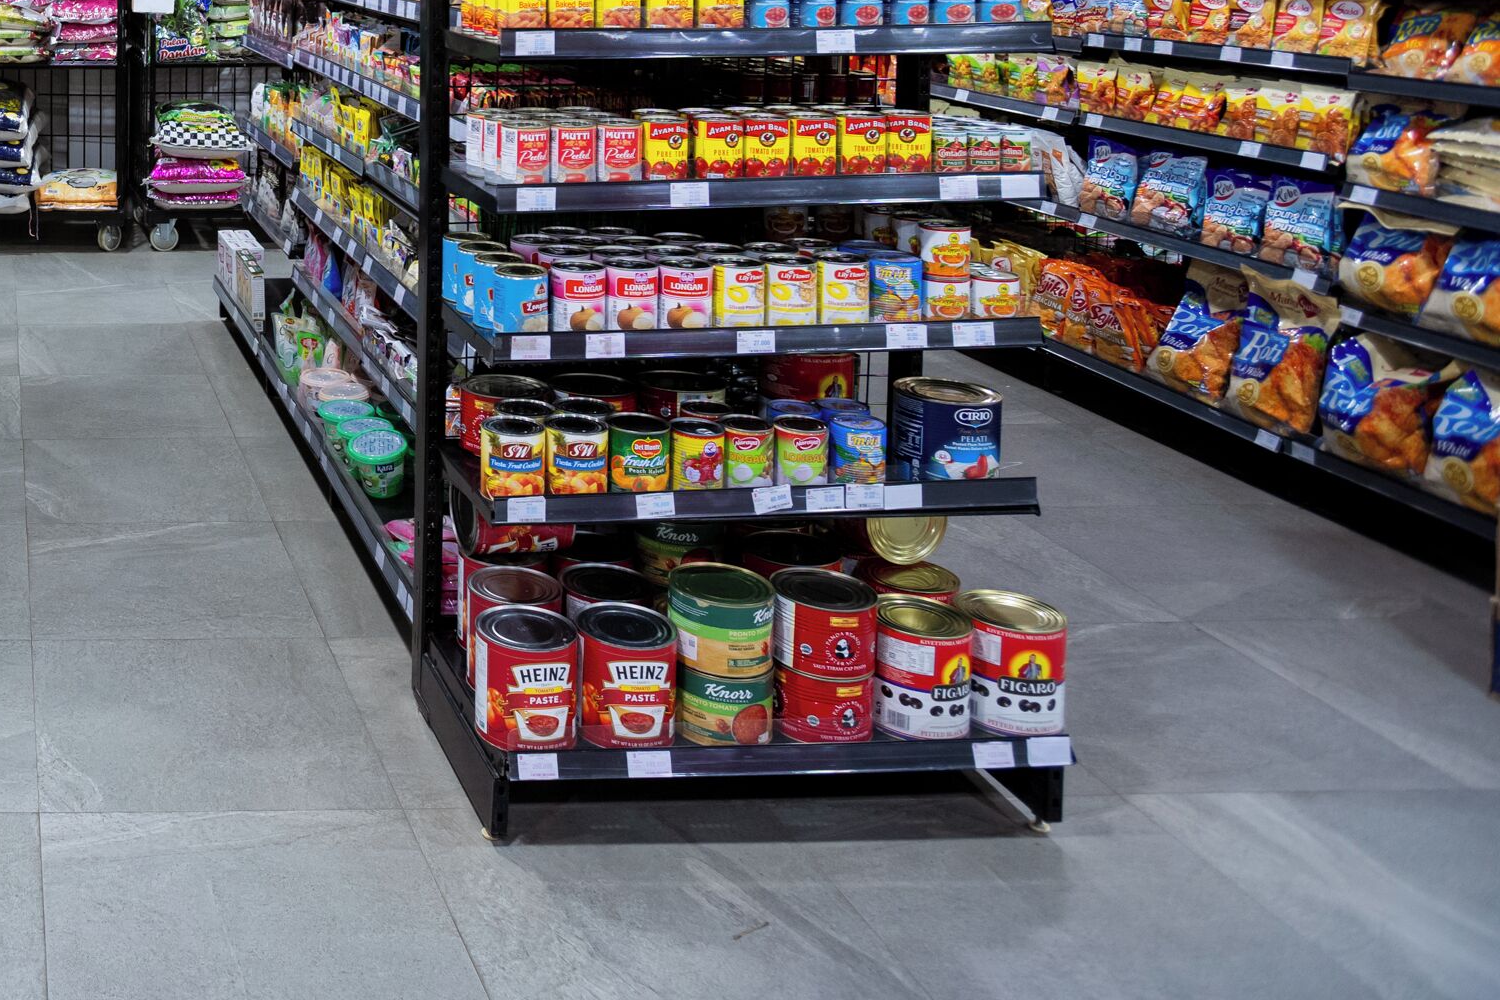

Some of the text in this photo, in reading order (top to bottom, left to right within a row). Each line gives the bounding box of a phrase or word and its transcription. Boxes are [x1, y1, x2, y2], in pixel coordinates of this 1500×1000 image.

[555, 0, 577, 8] Baked
[160, 46, 206, 60] Pandan
[768, 124, 789, 134] BRAND
[849, 121, 871, 131] AYAM
[519, 133, 547, 141] MUTTI
[561, 132, 590, 140] MUTTI
[606, 131, 635, 139] MUTTI
[520, 151, 548, 162] Peeled
[561, 149, 591, 163] Peeled
[605, 148, 636, 161] Peeled
[1149, 183, 1171, 193] PUTIH
[1214, 182, 1235, 195] Kobe
[1276, 186, 1300, 201] Kobe
[1211, 216, 1236, 226] PUTIH
[1272, 221, 1301, 233] PUTIH
[1360, 249, 1392, 264] White
[739, 274, 750, 282] Lily
[781, 271, 812, 282] Lily Flower
[837, 269, 867, 279] Lily Flower
[624, 283, 654, 291] LONGAN
[670, 282, 703, 291] LONGAN
[753, 339, 771, 347] 27.000
[1160, 332, 1188, 349] White
[1242, 331, 1286, 365] Roti
[959, 412, 990, 420] CIRIO
[1437, 440, 1470, 457] White
[623, 455, 666, 467] Fresh Cut
[377, 465, 394, 473] kara
[656, 526, 699, 543] Knorr
[520, 666, 567, 683] HEINZ
[616, 665, 664, 680] HEINZ
[704, 682, 753, 700] Knorr
[1000, 680, 1056, 694] FIGARO
[529, 696, 560, 704] PASTE
[624, 694, 656, 702] PASTE
[709, 702, 738, 712] TOMATO
[988, 718, 1039, 733] PITTED BLACK
